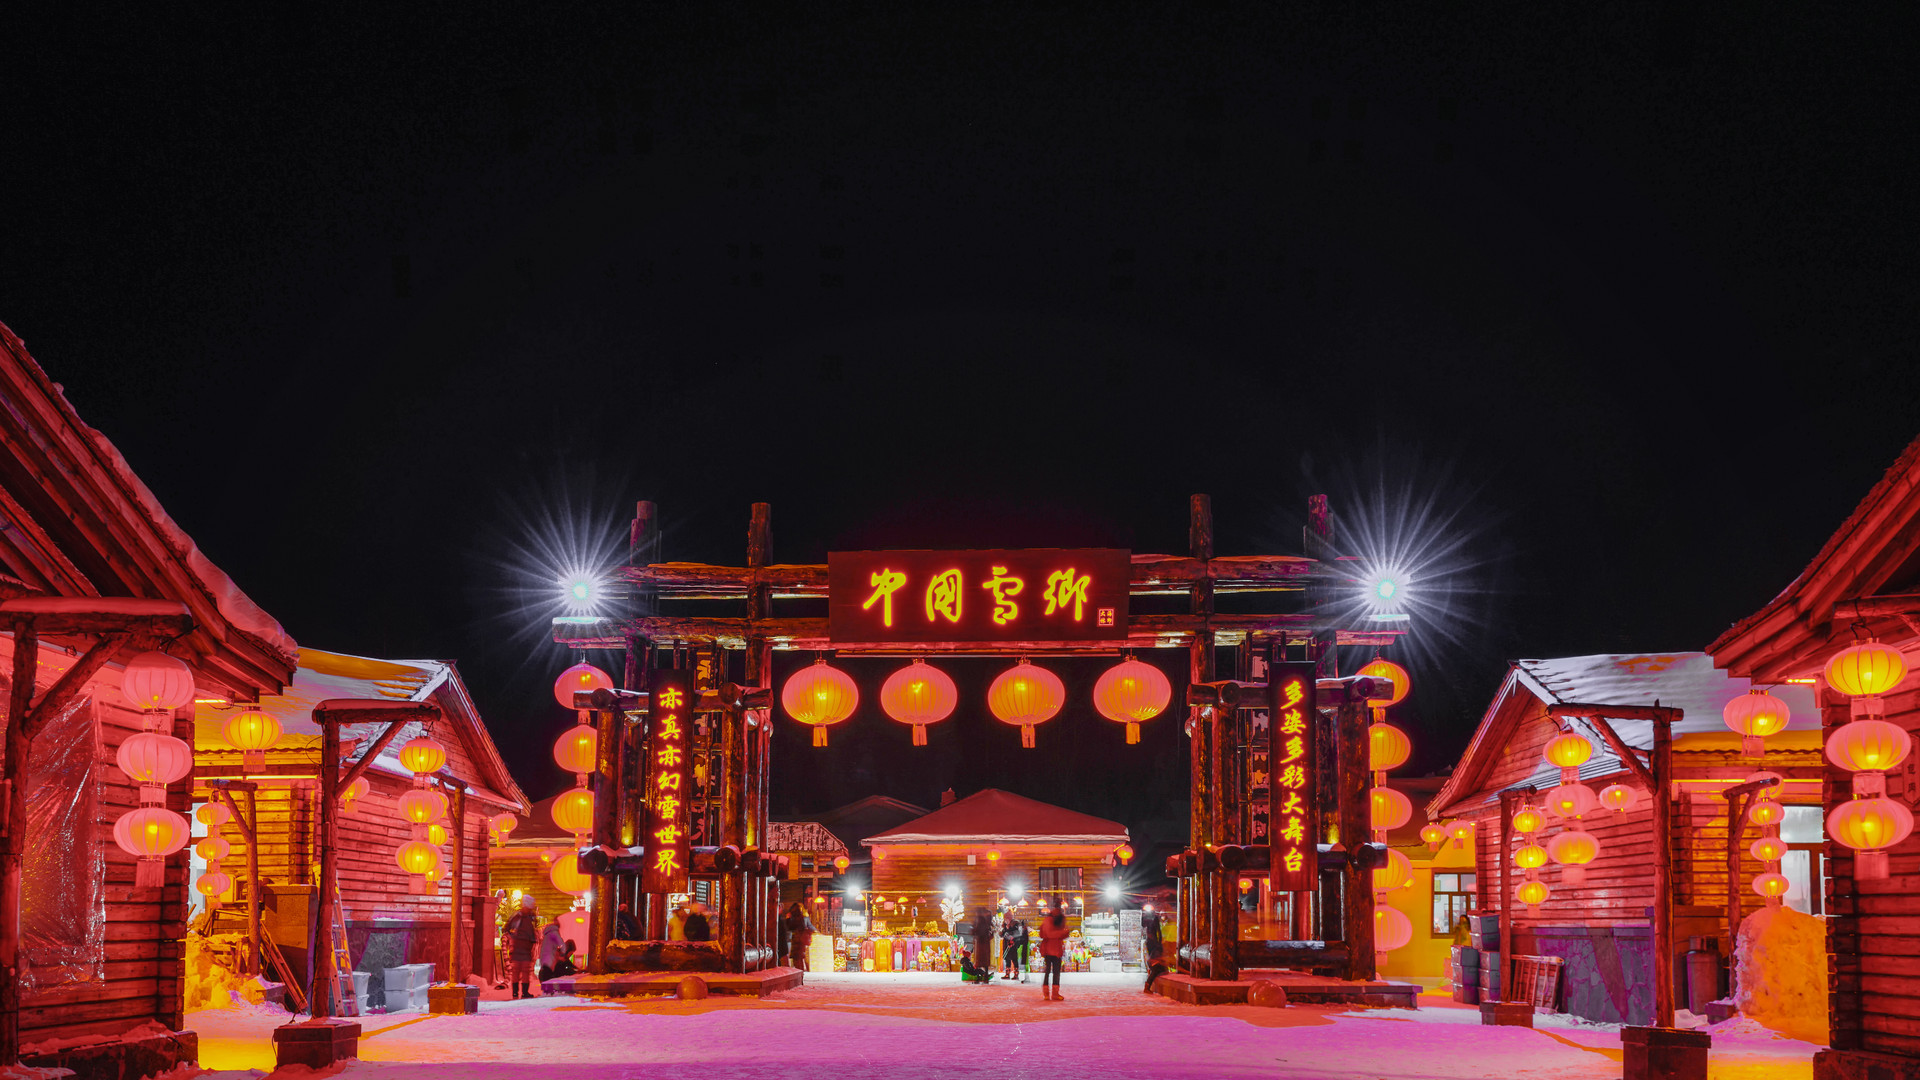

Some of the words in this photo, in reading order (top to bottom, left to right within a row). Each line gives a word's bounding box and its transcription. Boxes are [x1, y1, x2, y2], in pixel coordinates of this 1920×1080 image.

[653, 687, 683, 877] 亦真亦幻雪世界
[1279, 681, 1306, 872] 多姿多彩大舞台
